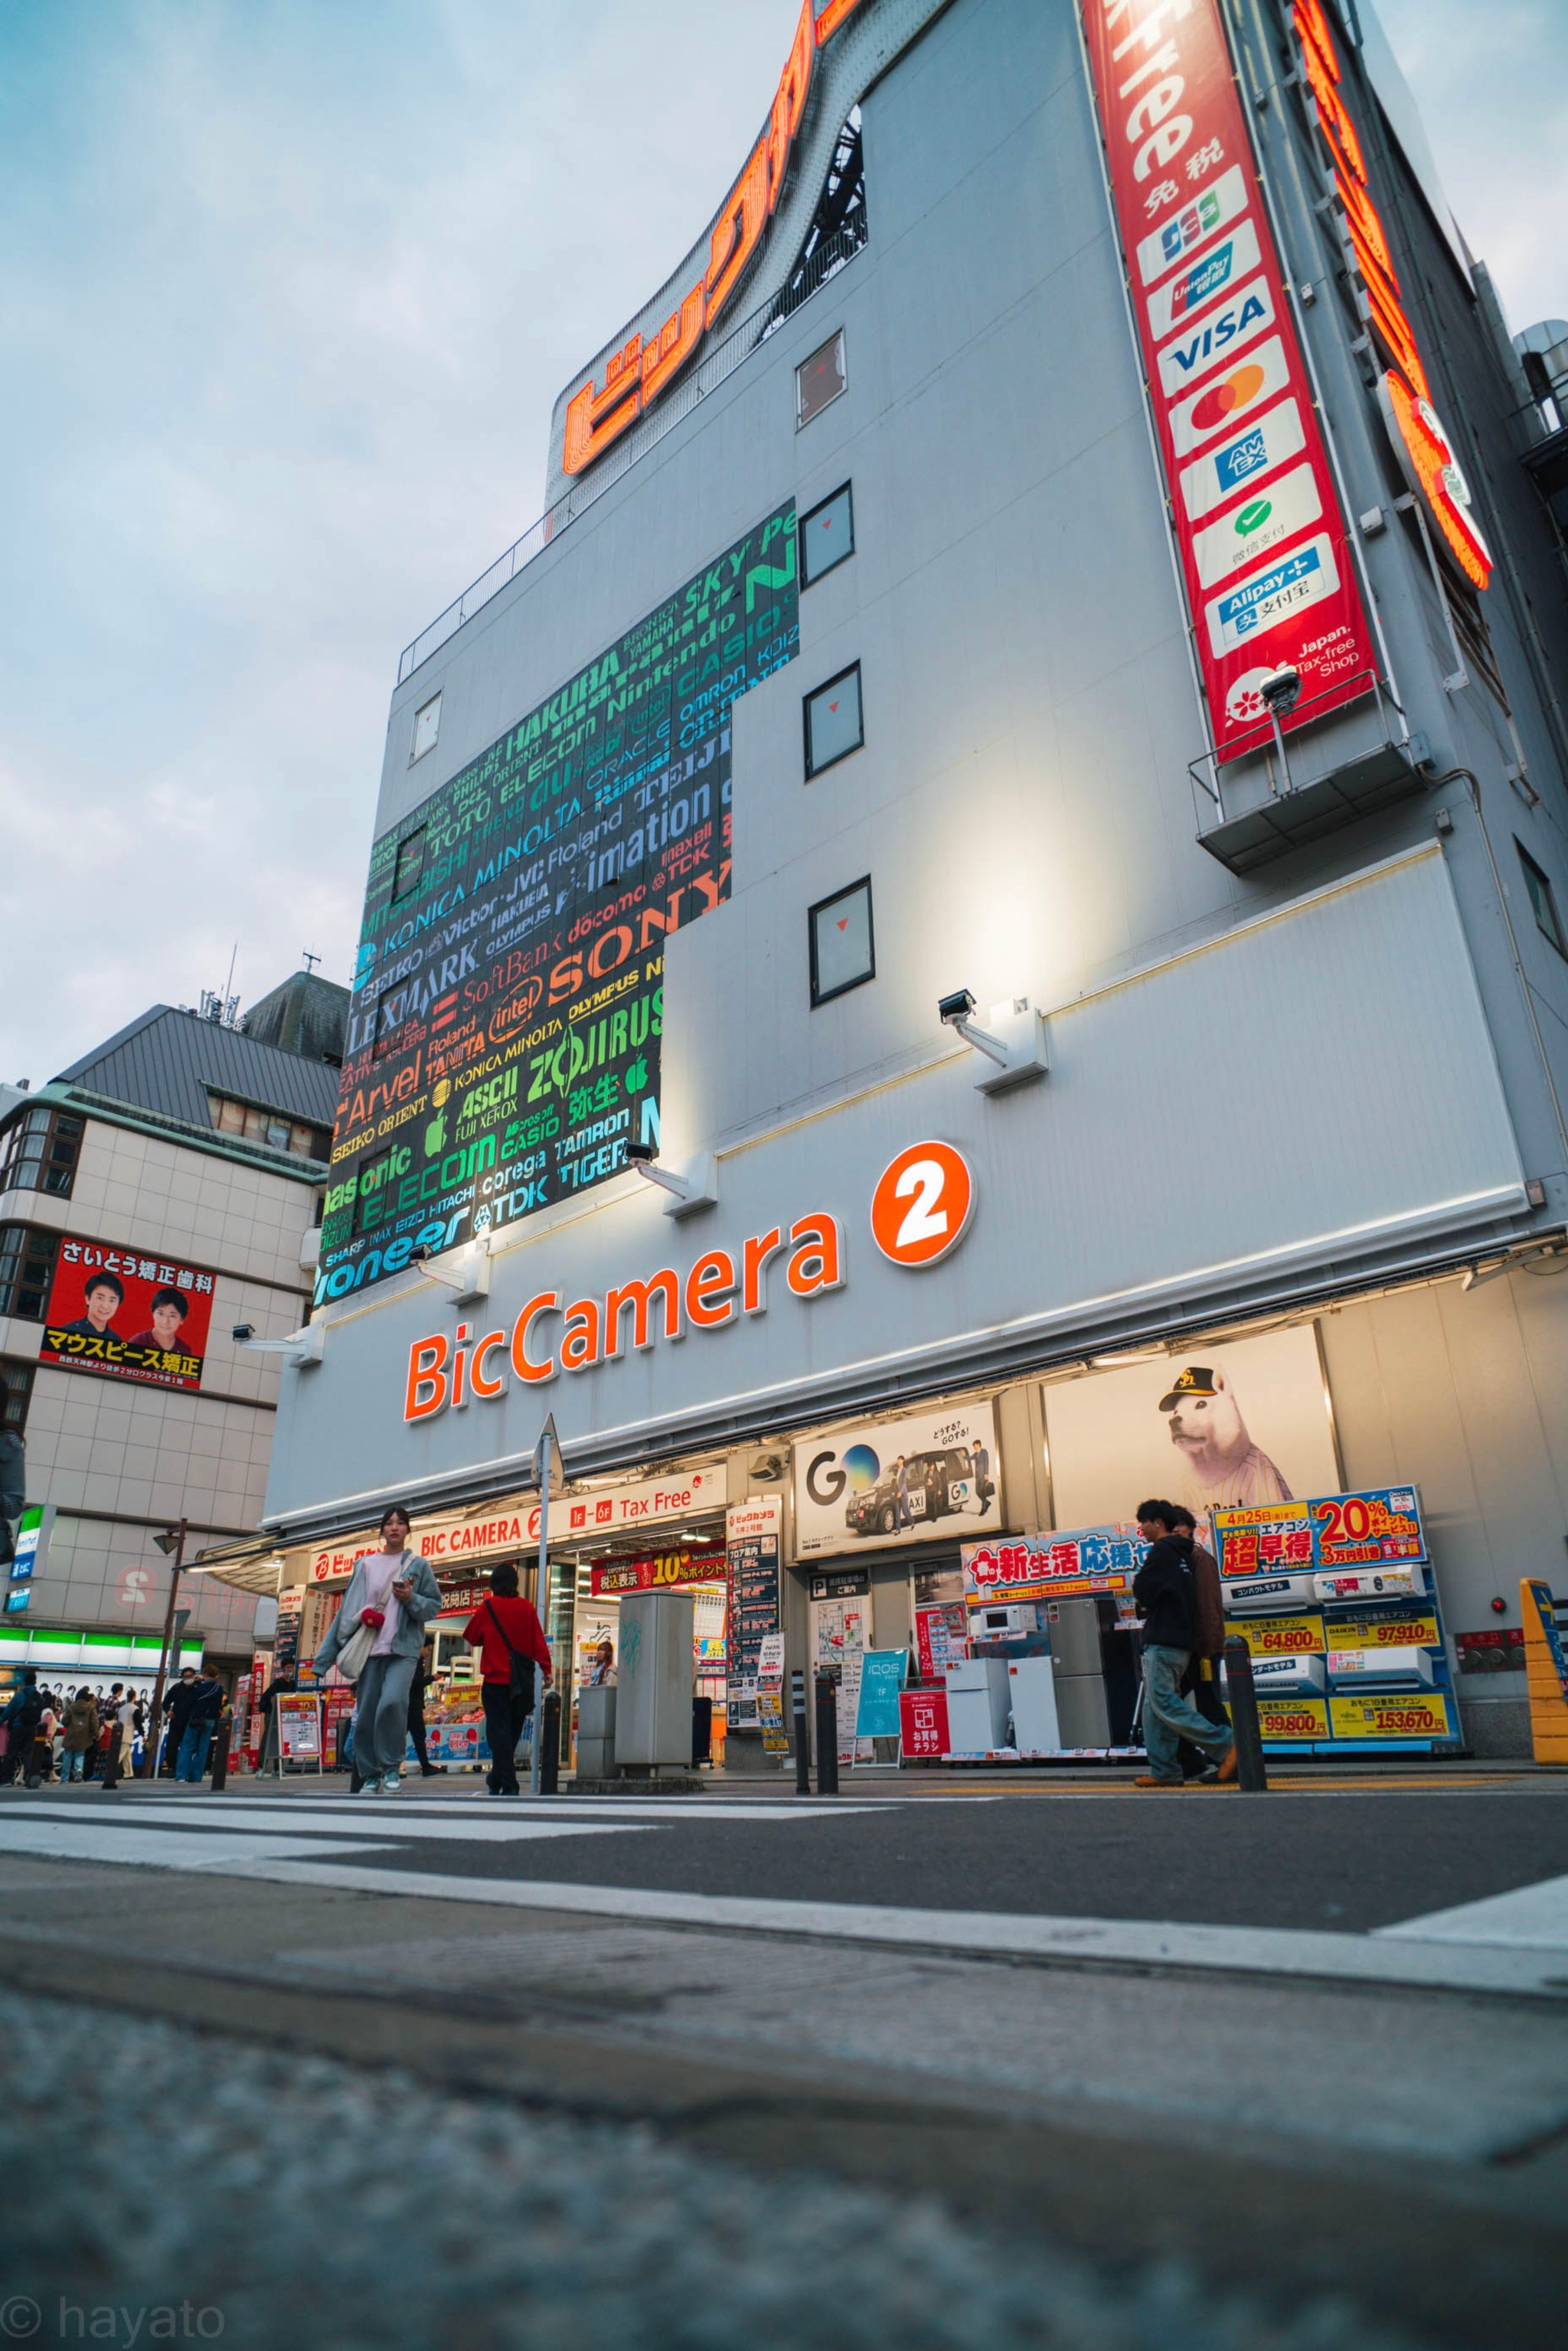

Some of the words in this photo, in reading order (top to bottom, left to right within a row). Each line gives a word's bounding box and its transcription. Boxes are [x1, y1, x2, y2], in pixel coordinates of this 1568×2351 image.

[1144, 136, 1225, 220] 免税
[1173, 254, 1232, 302] UnionPay
[1166, 295, 1266, 372] VISA
[682, 538, 752, 618] SKY
[1259, 580, 1311, 619] 支付宝
[629, 616, 675, 661] YAMAHA
[677, 605, 781, 699] CASIO
[1295, 638, 1355, 674] Tax-free
[1298, 625, 1351, 658] Japan.
[606, 612, 737, 723] Nintendo
[1319, 651, 1360, 678] Shop
[505, 649, 620, 762] HAKUBA
[492, 739, 542, 788] ORIENT
[586, 717, 671, 790] ORACLE
[529, 759, 572, 812] au
[430, 797, 492, 858] TOTO
[547, 803, 622, 874] Roland
[587, 782, 710, 893] imation
[662, 820, 712, 866] maxell
[382, 883, 466, 961] KONICA
[472, 797, 581, 896] MINOLTA
[668, 842, 710, 881] TDK
[443, 896, 495, 946] Victor
[507, 862, 544, 903] JVC
[490, 882, 549, 934] HAKUBA
[567, 884, 647, 944] docomo
[485, 903, 552, 956] OLYMPUS
[547, 857, 732, 1008] SONY
[360, 947, 424, 1007] SEIKO
[462, 932, 563, 1012] SoftBank
[568, 968, 640, 1020] OLYMPUS
[346, 937, 482, 1057] LEXMARK
[424, 1030, 486, 1086] TANITA
[427, 1014, 476, 1057] Roland
[454, 1052, 502, 1092] KONICA
[504, 1017, 564, 1064] MINOLTA
[346, 1050, 422, 1130] Arvel
[456, 1065, 518, 1125] ASCII
[568, 1072, 619, 1126] 弥生
[377, 1094, 430, 1136] ORIENT
[455, 1118, 476, 1144] FUJI
[479, 1096, 518, 1130] XEROX
[501, 1115, 560, 1161] CASIO
[505, 1102, 556, 1140] Microsoft
[332, 1125, 375, 1164] SEIKO
[482, 1149, 547, 1195] corega
[395, 1208, 426, 1232] EIZO
[428, 1184, 475, 1219] HITACHI
[492, 1174, 548, 1223] TDK
[325, 1238, 366, 1268] SHARP
[368, 1225, 392, 1247] INAX
[62, 1241, 214, 1295] さいとう矯正歯科
[403, 1211, 840, 1423] BicCamera
[894, 1158, 949, 1249] 2
[46, 1328, 201, 1378] マウスピース矯正
[933, 1420, 962, 1440] どうする?
[941, 1427, 970, 1446] GOする!
[619, 1498, 649, 1518] Tax
[654, 1490, 691, 1512] Free
[736, 1510, 775, 1523] ビックカメラ
[908, 1494, 925, 1510] AXI
[421, 1533, 446, 1557] BIC
[449, 1517, 521, 1552] CAMERA
[1261, 1519, 1310, 1536] エアコン
[1221, 1530, 1313, 1577] 超早得
[599, 1572, 638, 1591] 税込表示
[815, 1581, 824, 1595] P
[1236, 1582, 1284, 1597] コンパクトモデル
[1263, 1631, 1313, 1650] 64,800
[1376, 1624, 1426, 1642] 97,910
[867, 1663, 900, 1675] IQOS
[912, 1729, 939, 1742] お買得
[1264, 1714, 1316, 1732] 99,800
[1376, 1710, 1434, 1729] 153,670
[913, 1742, 939, 1753] チラシ
